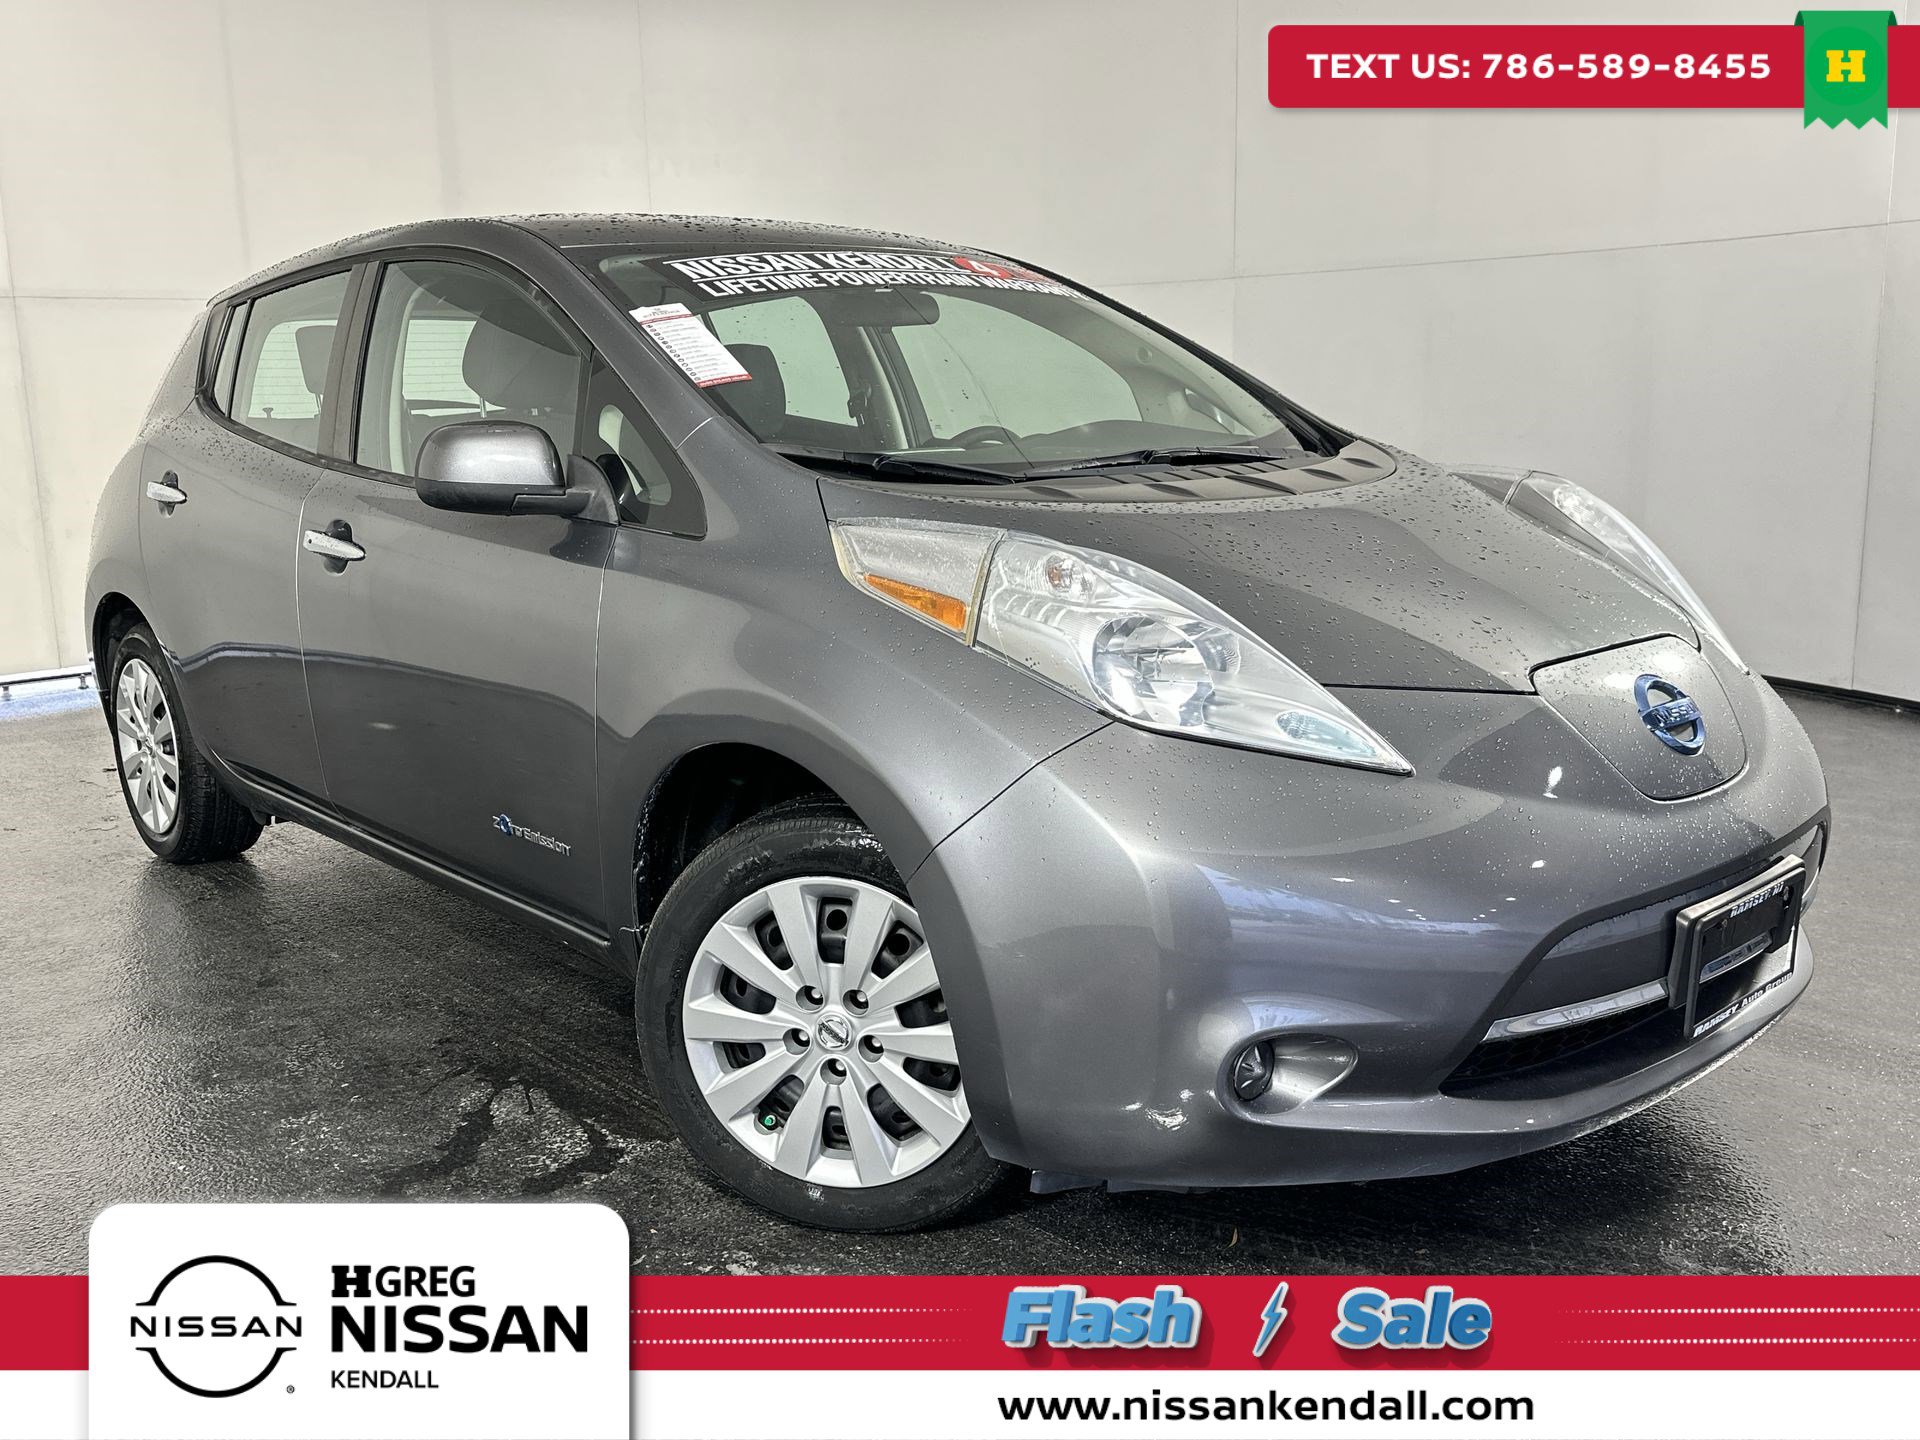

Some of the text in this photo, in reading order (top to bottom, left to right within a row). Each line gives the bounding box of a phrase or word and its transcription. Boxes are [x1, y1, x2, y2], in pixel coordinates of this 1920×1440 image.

[671, 252, 824, 280] NISSAN
[814, 252, 972, 274] KENDALL
[697, 271, 828, 297] LIFETIME
[818, 270, 982, 288] POWERTRAIN
[1693, 970, 1794, 1038] RAMSEY Auto Group
